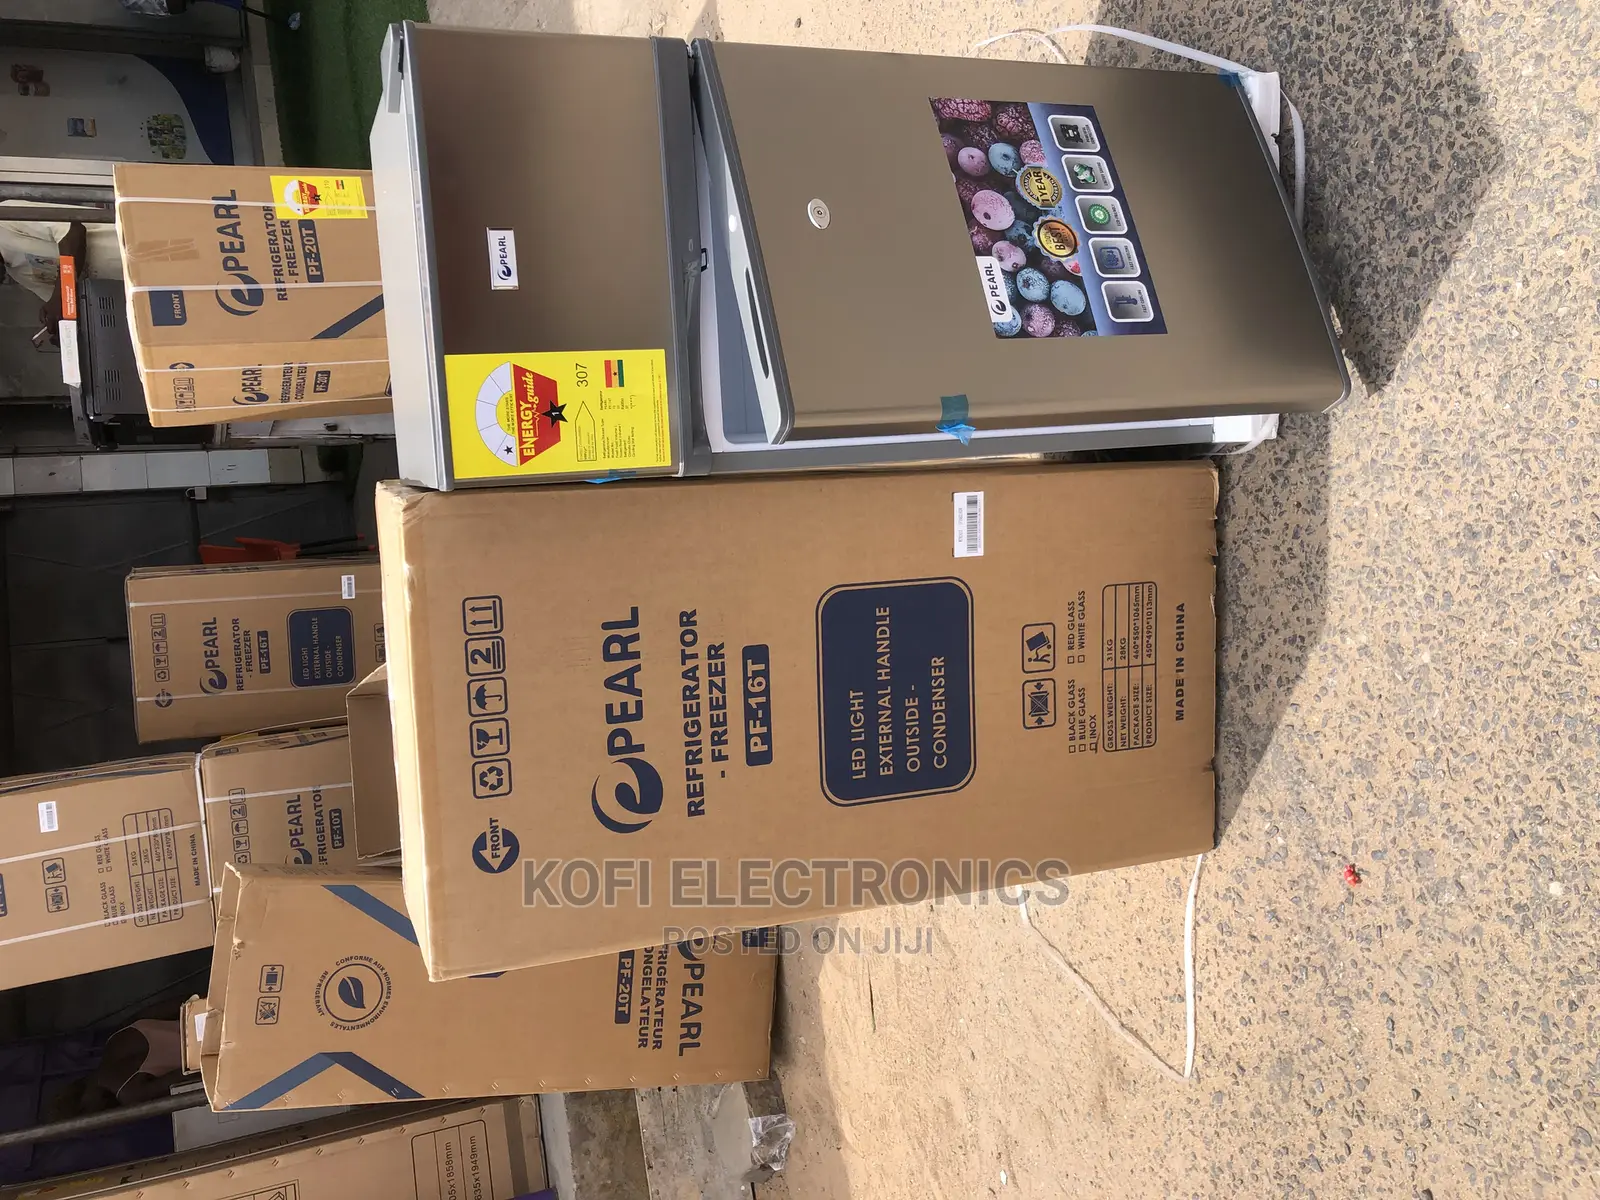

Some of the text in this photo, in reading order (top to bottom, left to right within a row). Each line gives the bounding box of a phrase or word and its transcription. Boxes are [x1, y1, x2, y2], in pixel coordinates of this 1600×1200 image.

[1033, 171, 1048, 198] YEAR
[212, 189, 249, 271] PEARL
[280, 220, 298, 276] FREEZER
[302, 228, 320, 275] PF-20T
[498, 236, 508, 265] PEARL
[1049, 226, 1066, 250] BEST
[172, 292, 181, 318] FRONT
[984, 263, 1000, 298] PEARL
[575, 363, 589, 388] 307
[520, 372, 539, 456] ENERGY guide
[202, 617, 220, 669] PEARL
[1067, 601, 1075, 651] RED GLASS
[1077, 590, 1086, 650] WHITE GLASS
[232, 618, 244, 691] REFRIGERATOR
[243, 630, 253, 672] FREEZER
[259, 635, 269, 669] PF-16T
[301, 647, 309, 666] LIGHT
[311, 617, 321, 679] EXTERNAL HANDLE
[325, 650, 333, 678] OUTSIDE
[335, 635, 344, 676] CONDENSER
[1105, 638, 1114, 662] 31KG
[1118, 637, 1127, 661] 28KG
[1175, 602, 1186, 721] MADE IN CHINA
[600, 606, 645, 757] PEARL
[707, 642, 729, 763] FREEZER
[747, 659, 769, 753] PF-16T
[876, 606, 893, 776] EXTERNAL HANDLE
[679, 609, 705, 818] REFRIGERATOR
[849, 690, 866, 780] LED LIGHT
[904, 697, 921, 773] OUTSIDE
[930, 656, 947, 770] CONDENSER
[1067, 679, 1077, 742] BLACK GLASS
[1078, 687, 1087, 740] BLUE GLASS
[1088, 714, 1097, 740] INOX
[1105, 682, 1115, 749] GROSS WEIGHT:
[1118, 695, 1128, 748] NET WEIGHT:
[1131, 683, 1141, 746] PACKAGE SIZE:
[1144, 684, 1154, 745] PRODUCT SIZE:
[286, 795, 304, 848] PEARL
[331, 811, 342, 847] PF-10T
[489, 818, 502, 860] FRONT
[189, 834, 201, 886] MADE IN CHINA
[335, 955, 374, 967] CONFORME
[372, 962, 386, 972] AUX
[382, 971, 392, 1000] NORMES
[618, 957, 632, 1015] PF-20T
[678, 963, 706, 1057] PEARL
